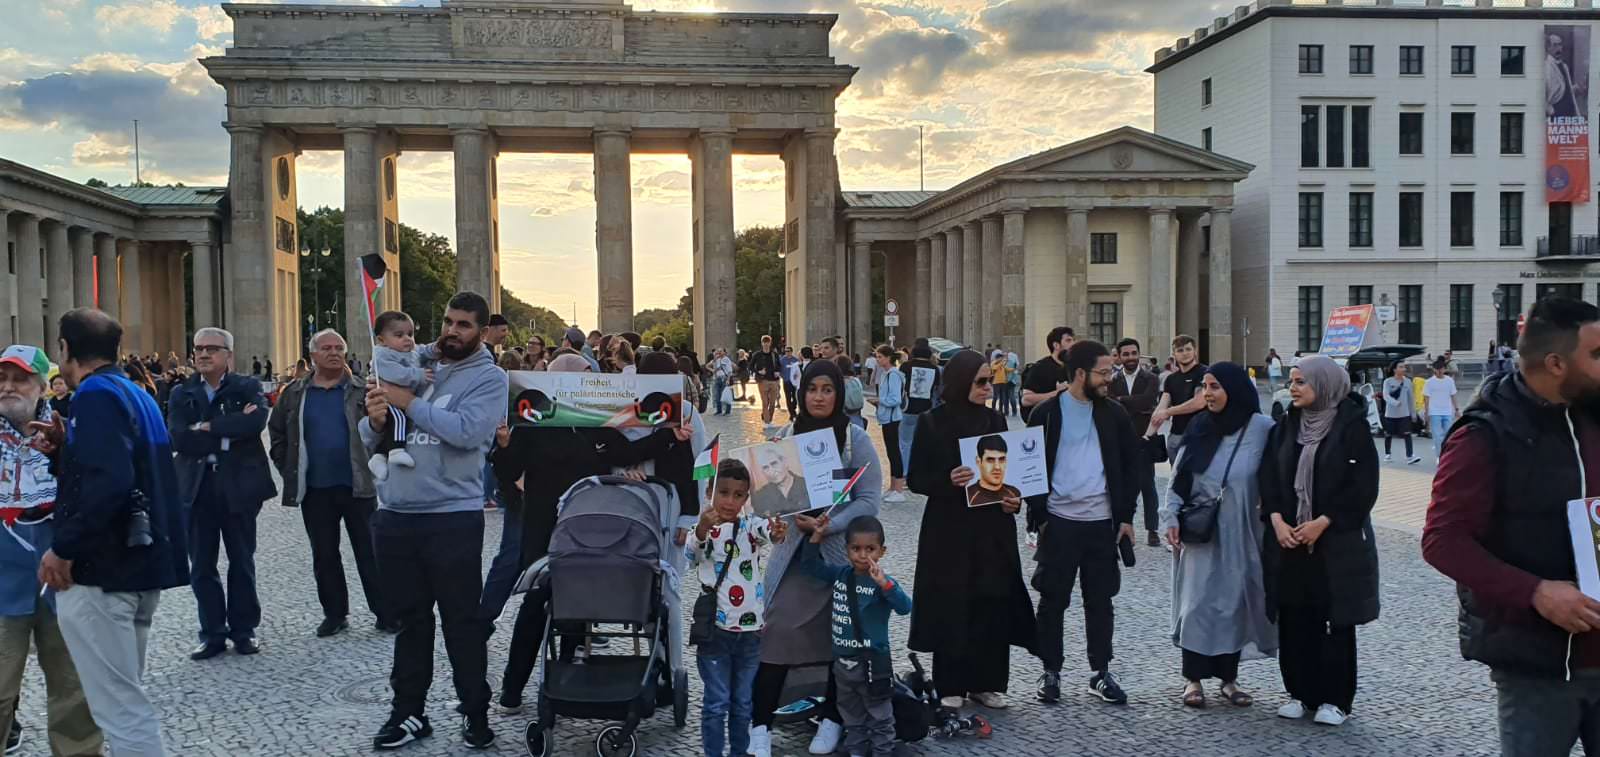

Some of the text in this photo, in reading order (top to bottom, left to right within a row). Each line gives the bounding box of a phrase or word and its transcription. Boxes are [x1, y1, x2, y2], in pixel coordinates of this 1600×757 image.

[1548, 116, 1588, 125] LIEBER-
[1548, 126, 1589, 135] MANNS
[1548, 135, 1578, 144] WELT
[580, 377, 612, 387] Freiheit
[407, 429, 440, 445] das
[855, 585, 876, 596] ORK
